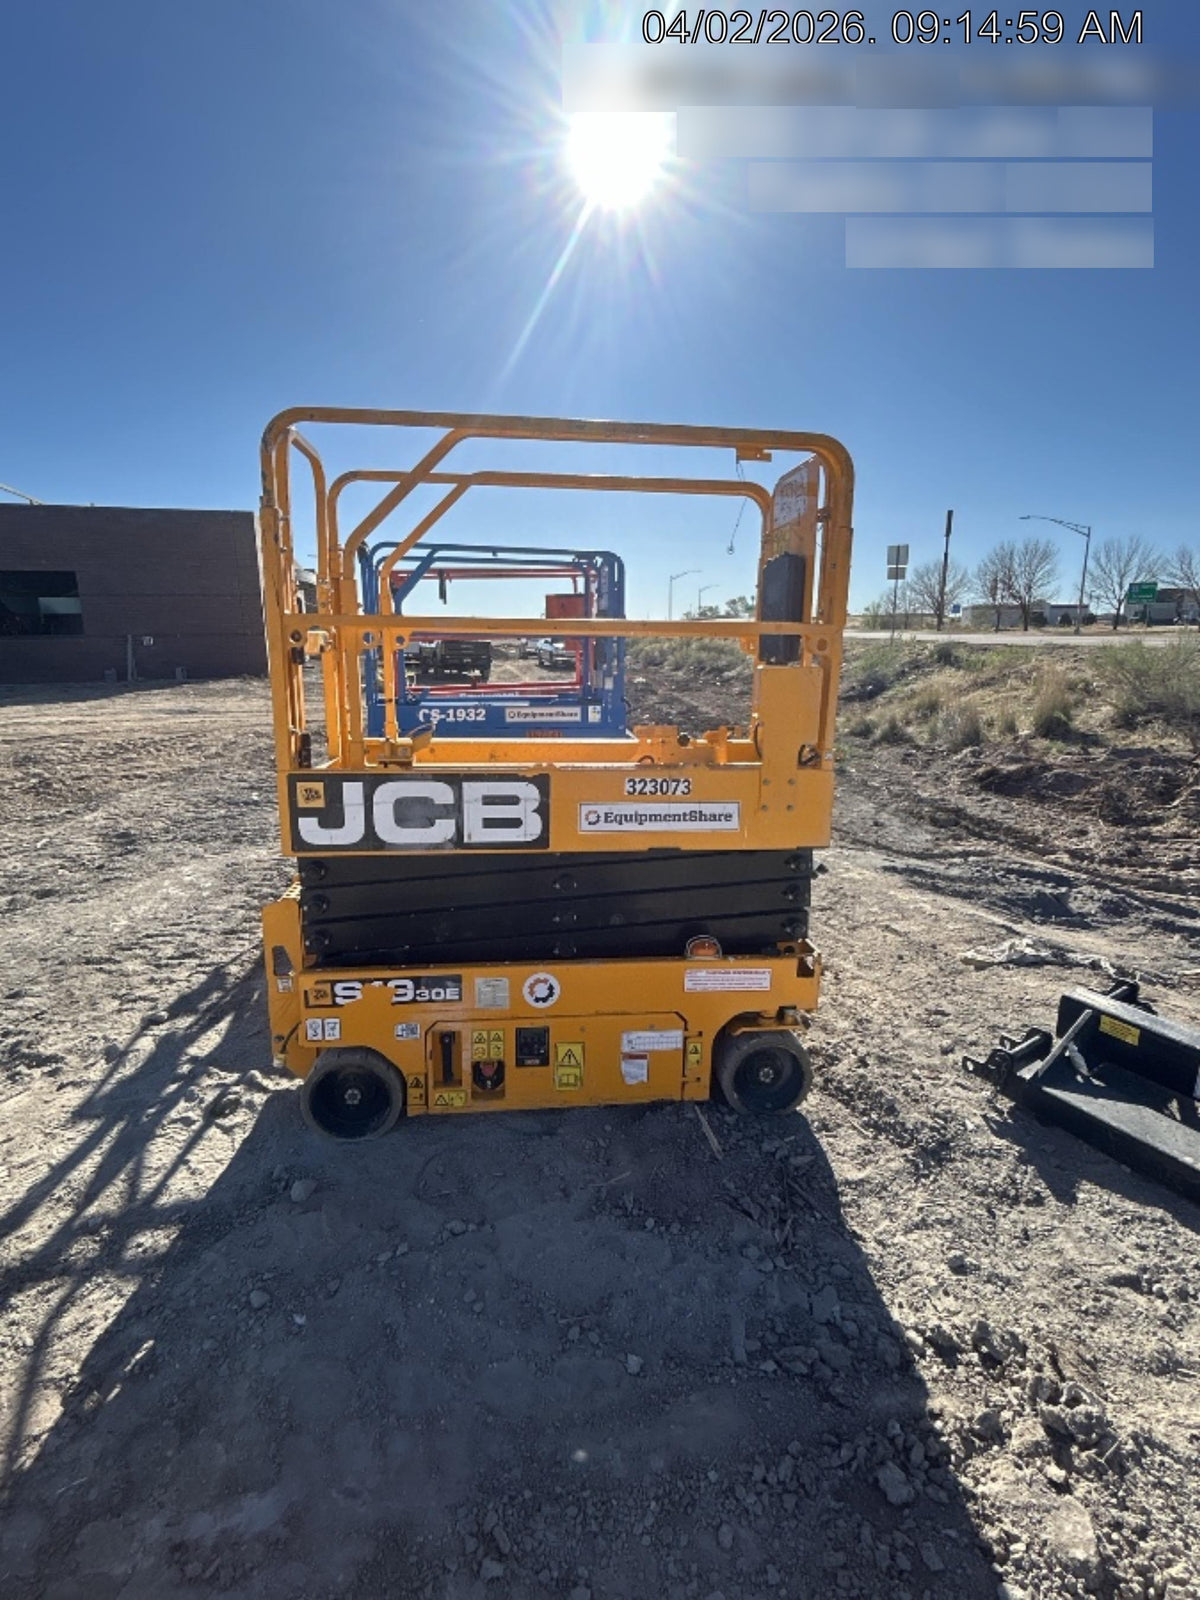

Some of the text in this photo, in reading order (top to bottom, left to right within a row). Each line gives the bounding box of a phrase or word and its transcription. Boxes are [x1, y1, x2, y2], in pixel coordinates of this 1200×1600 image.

[626, 778, 691, 795] 323073
[298, 781, 543, 845] JCB
[603, 810, 733, 826] EquipmentShare
